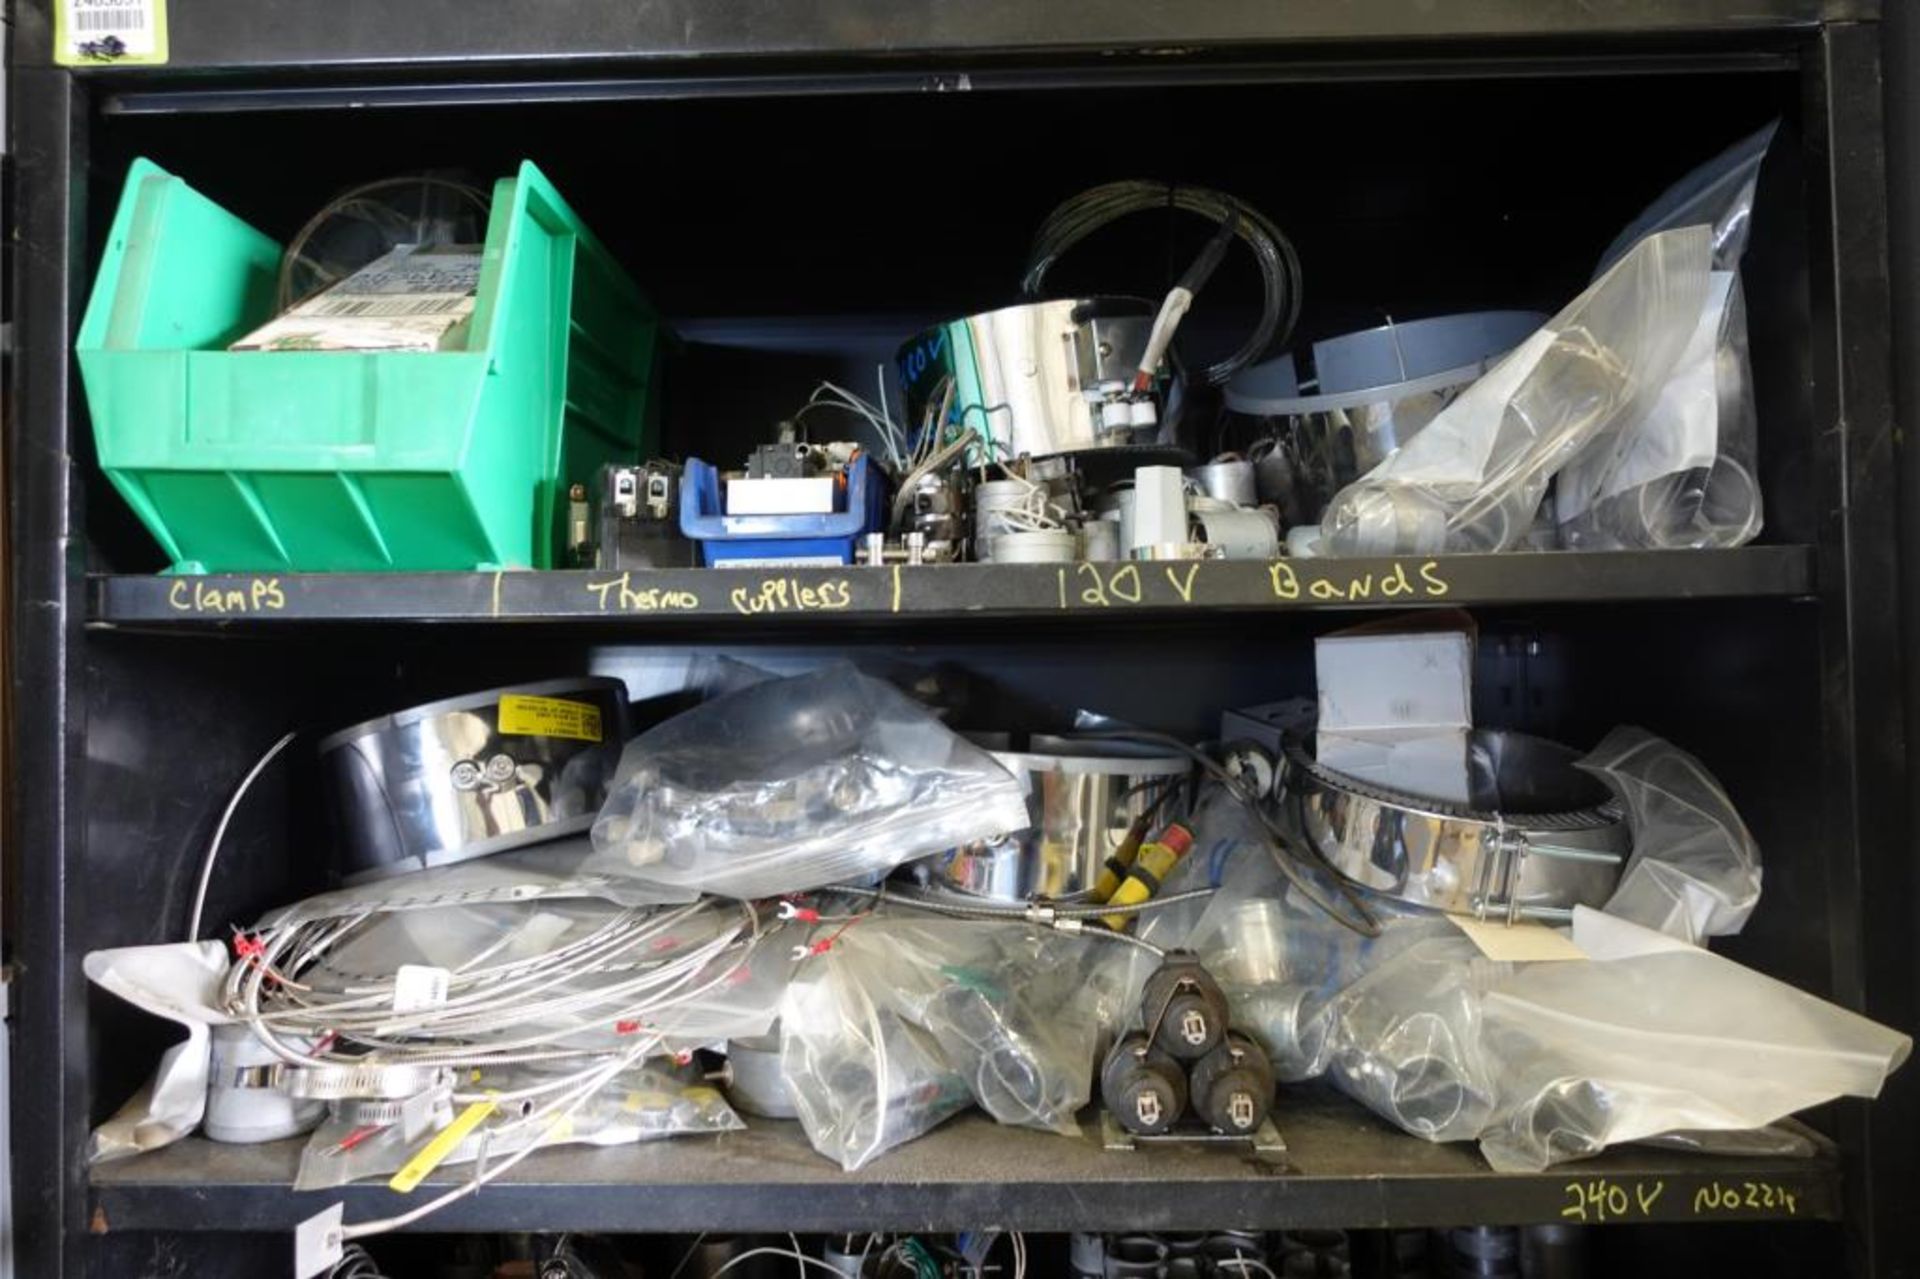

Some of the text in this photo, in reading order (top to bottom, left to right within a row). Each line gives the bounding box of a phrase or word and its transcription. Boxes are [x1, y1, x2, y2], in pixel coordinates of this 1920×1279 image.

[1057, 562, 1142, 608] 120
[1165, 563, 1200, 602] V
[1561, 1179, 1629, 1221] 240
[1636, 1180, 1664, 1215] V
